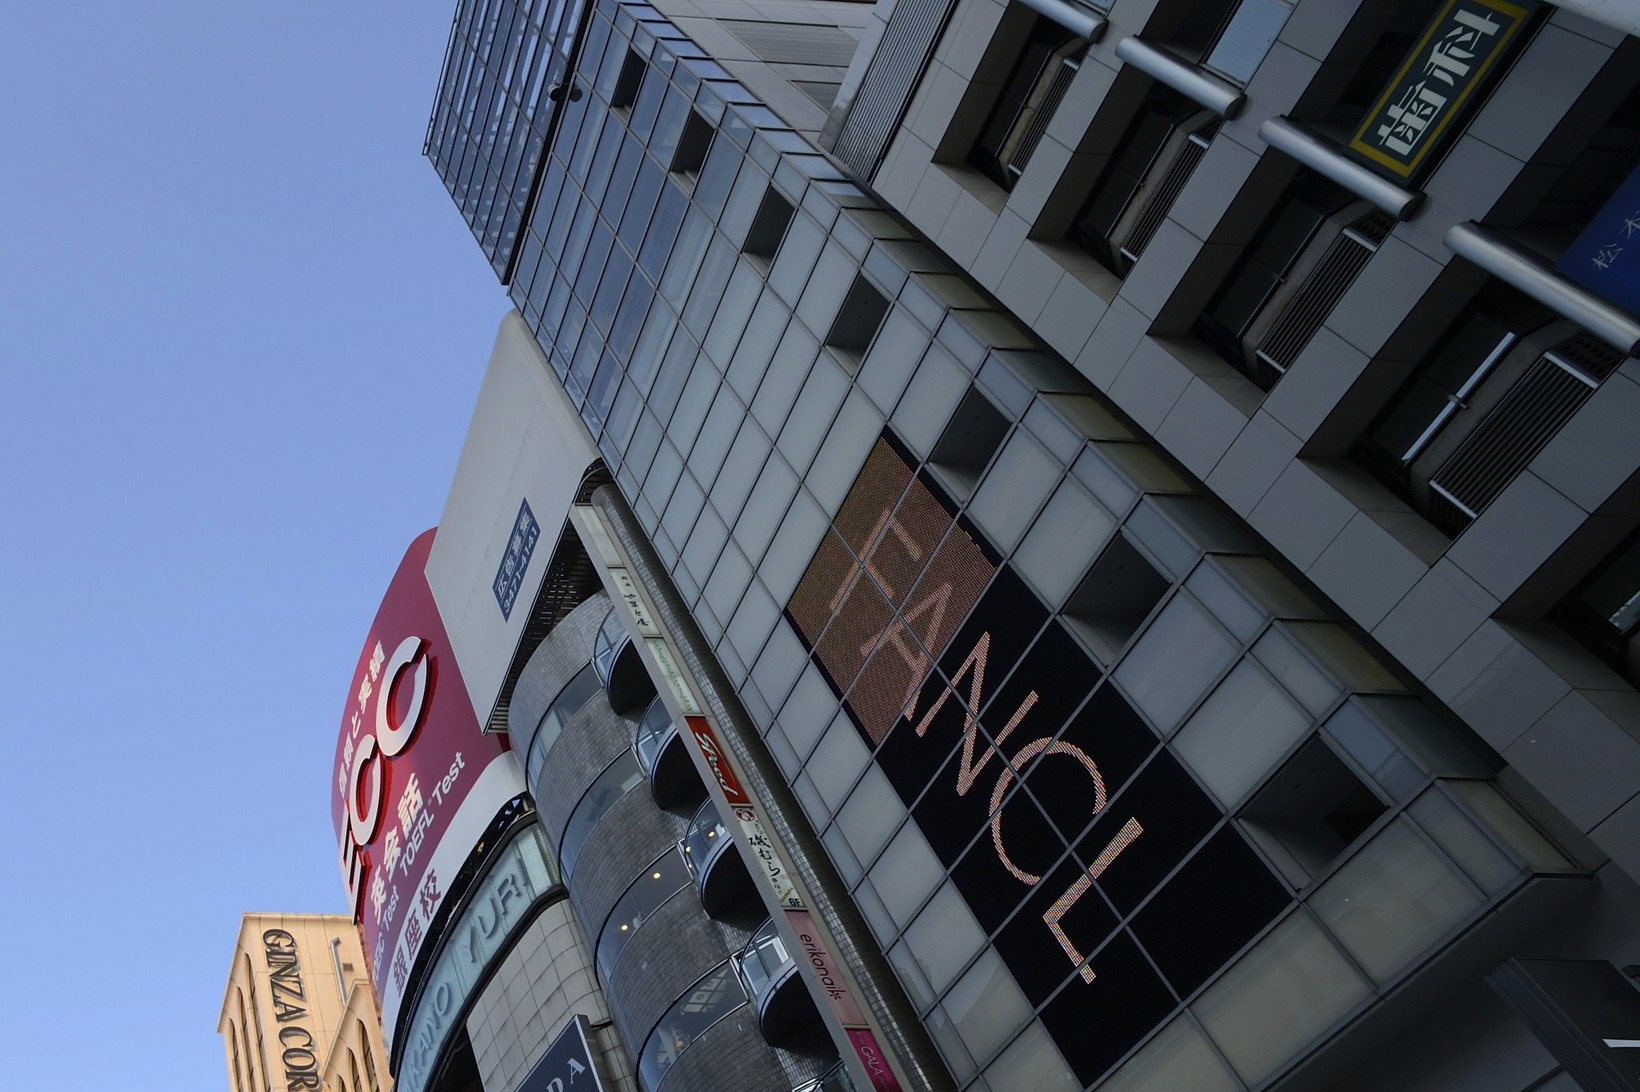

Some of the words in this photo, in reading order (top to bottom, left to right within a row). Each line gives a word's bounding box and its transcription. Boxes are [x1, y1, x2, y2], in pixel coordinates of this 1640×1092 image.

[1377, 9, 1501, 156] 歯科
[431, 751, 466, 806] Test
[828, 505, 1144, 985] FANCL
[371, 773, 424, 925] 英会話
[263, 928, 302, 1021] GINZA
[393, 869, 441, 996] 銀座校
